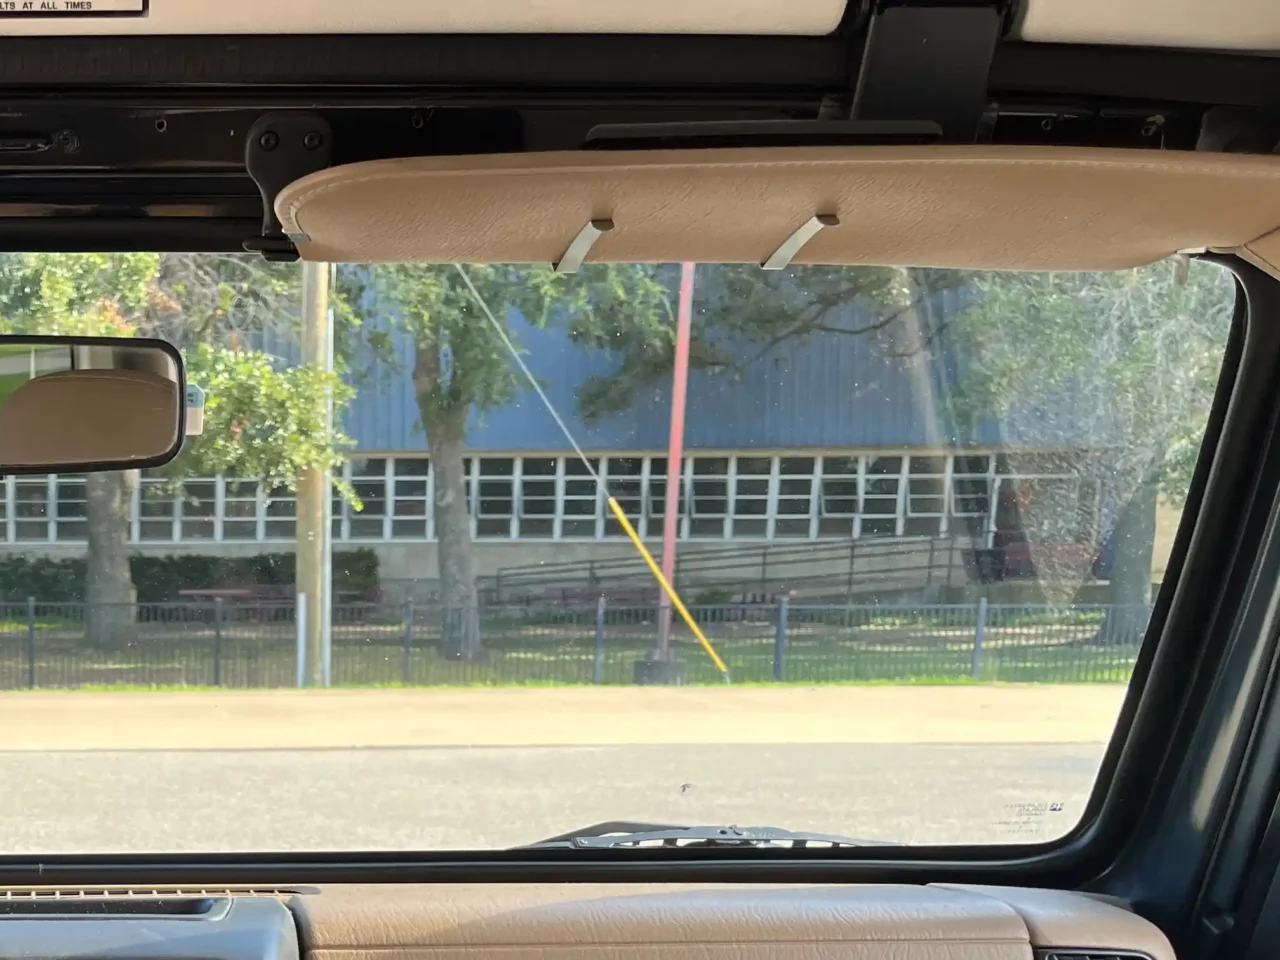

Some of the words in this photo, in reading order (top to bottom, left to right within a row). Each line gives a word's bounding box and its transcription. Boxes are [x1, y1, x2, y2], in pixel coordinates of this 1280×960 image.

[22, 2, 33, 10] AT
[40, 2, 58, 10] ALL
[64, 2, 92, 10] TIMES
